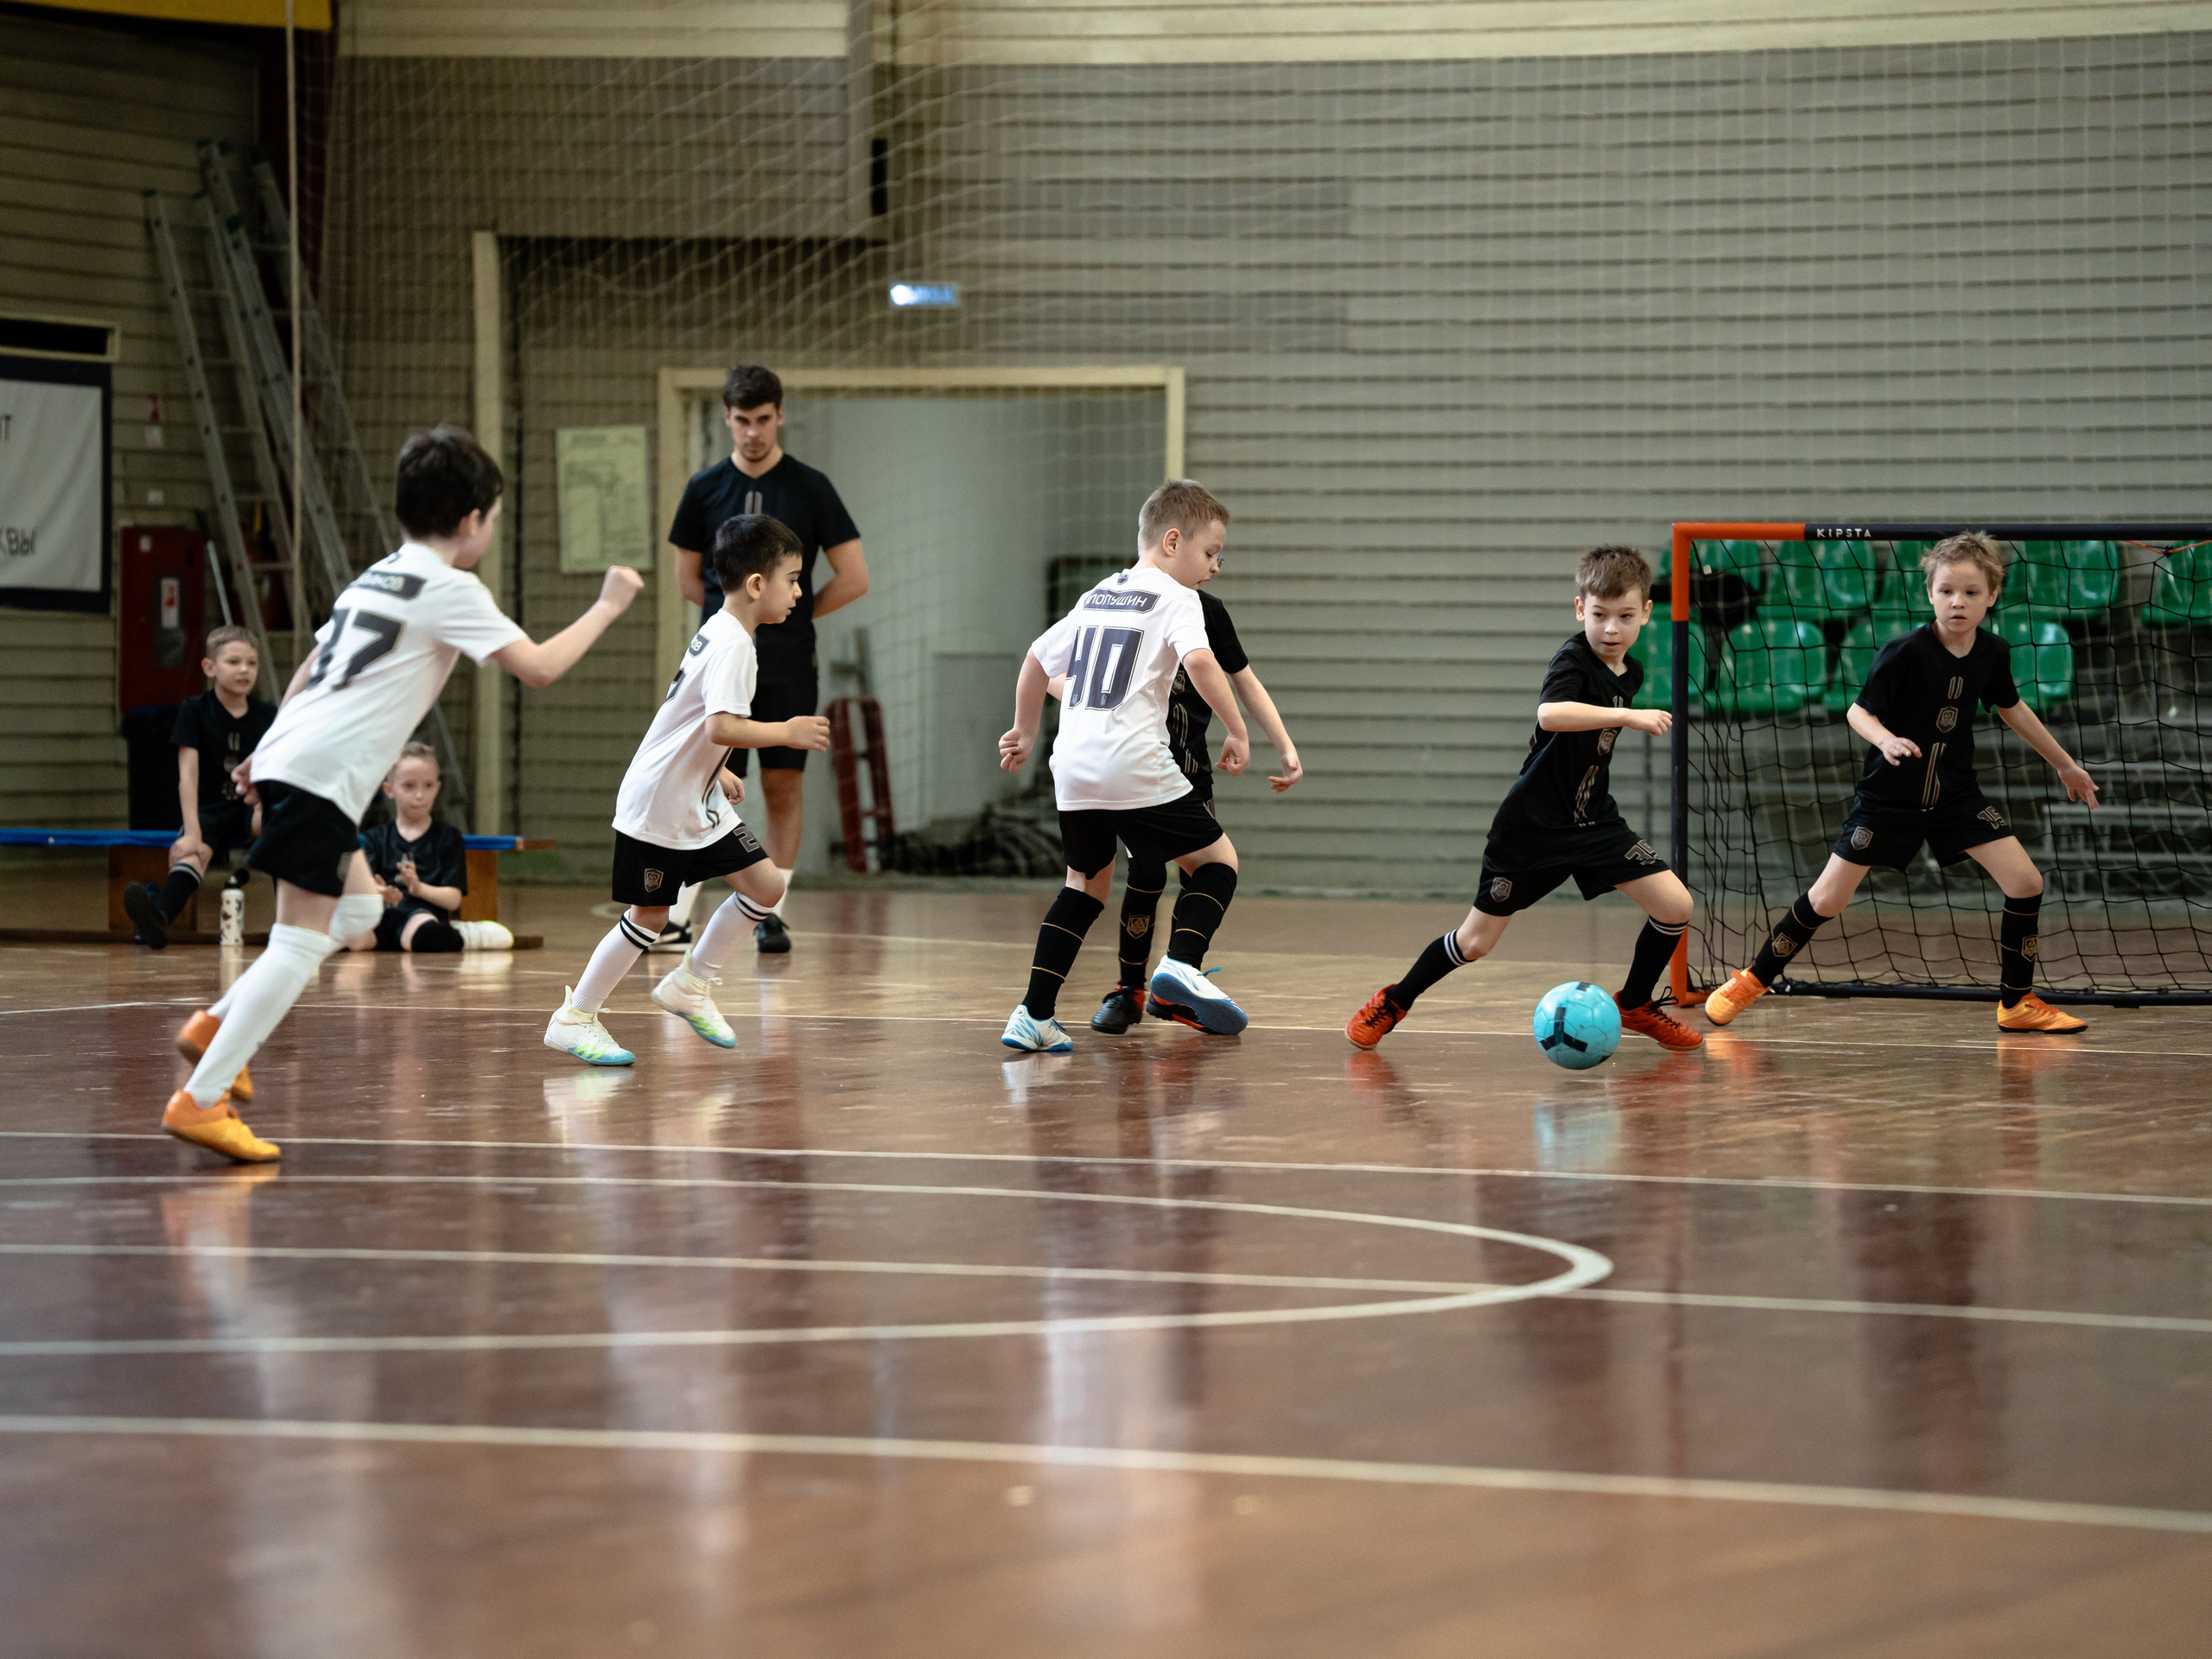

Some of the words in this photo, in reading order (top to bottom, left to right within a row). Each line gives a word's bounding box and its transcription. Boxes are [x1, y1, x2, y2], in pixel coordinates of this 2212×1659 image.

[0, 414, 12, 442] Т
[1816, 528, 1872, 537] KIPSTA
[1065, 625, 1145, 711] 40
